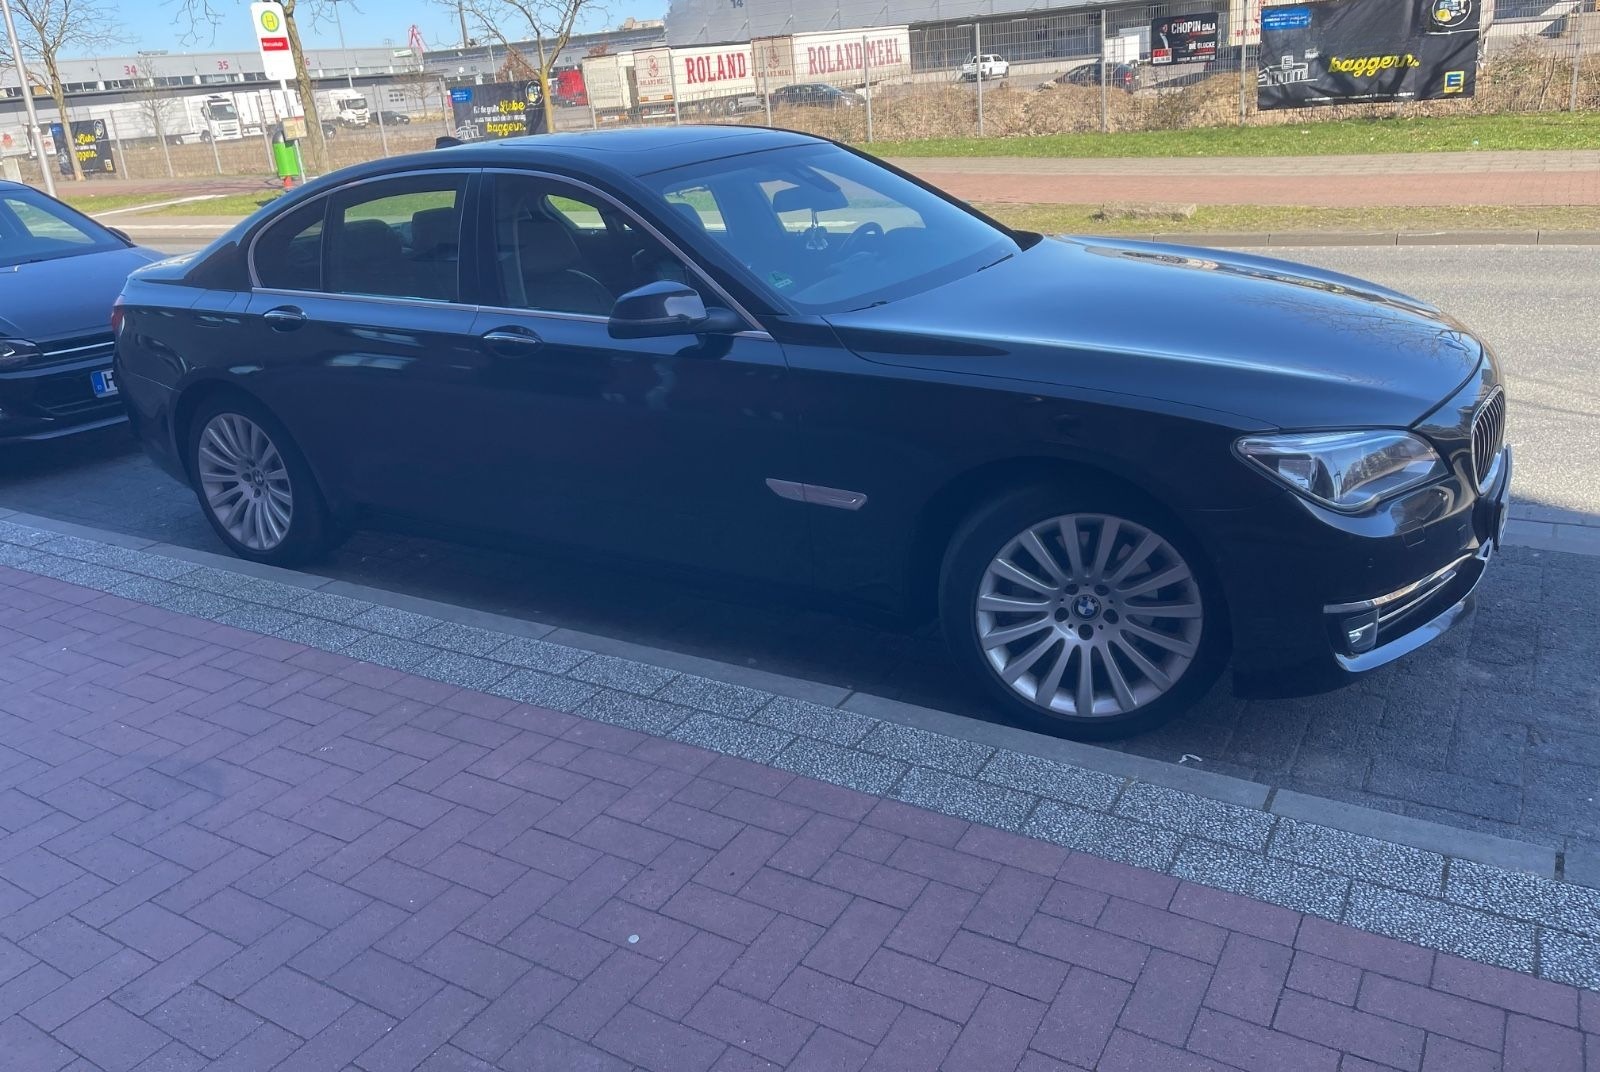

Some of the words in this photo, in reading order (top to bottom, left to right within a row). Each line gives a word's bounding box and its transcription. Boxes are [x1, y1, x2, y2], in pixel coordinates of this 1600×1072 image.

[265, 15, 276, 28] H
[1171, 20, 1201, 34] CHOPIN
[1201, 22, 1215, 31] GALA
[1236, 28, 1259, 37] ROLAN
[808, 42, 864, 75] ROLAND
[866, 38, 903, 67] MEHL
[124, 64, 138, 76] 34
[217, 60, 229, 71] 35
[685, 52, 747, 85] ROLAND
[1328, 54, 1420, 77] baggern.
[500, 99, 526, 114] Liebe
[486, 121, 527, 136] baggern.
